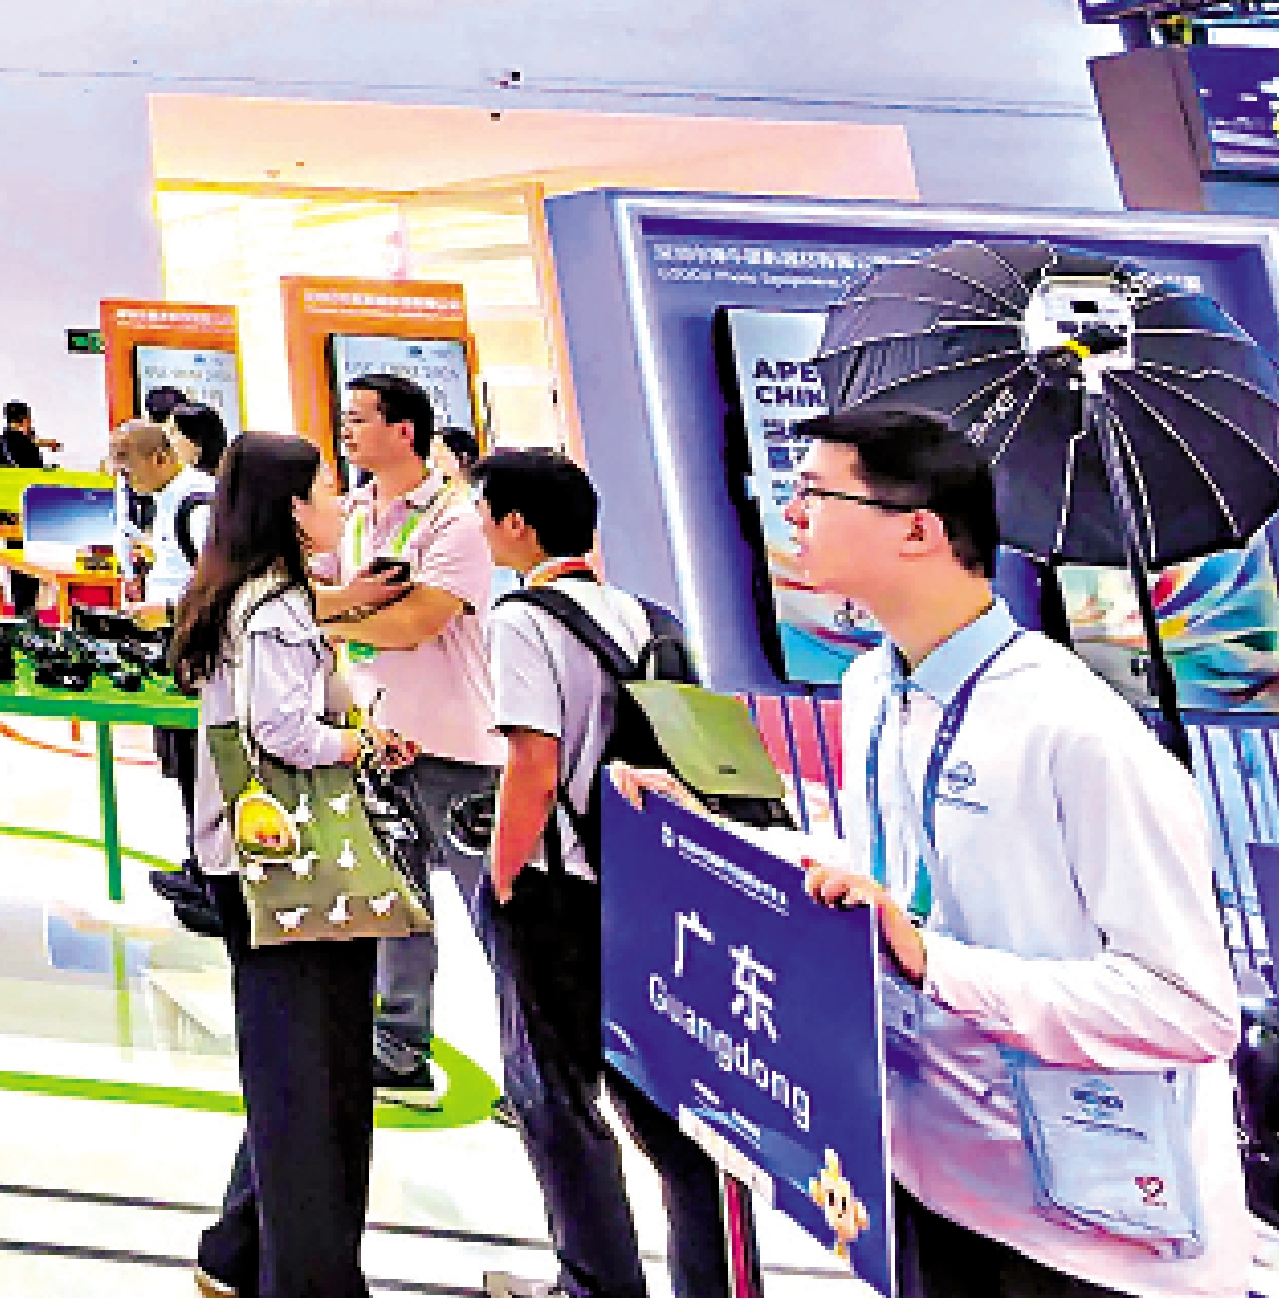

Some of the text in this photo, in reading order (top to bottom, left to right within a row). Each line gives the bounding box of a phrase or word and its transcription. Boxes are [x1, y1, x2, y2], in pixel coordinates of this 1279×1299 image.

[753, 359, 819, 382] APE
[674, 908, 780, 1043] 广东
[649, 972, 811, 1132] Guangdong
